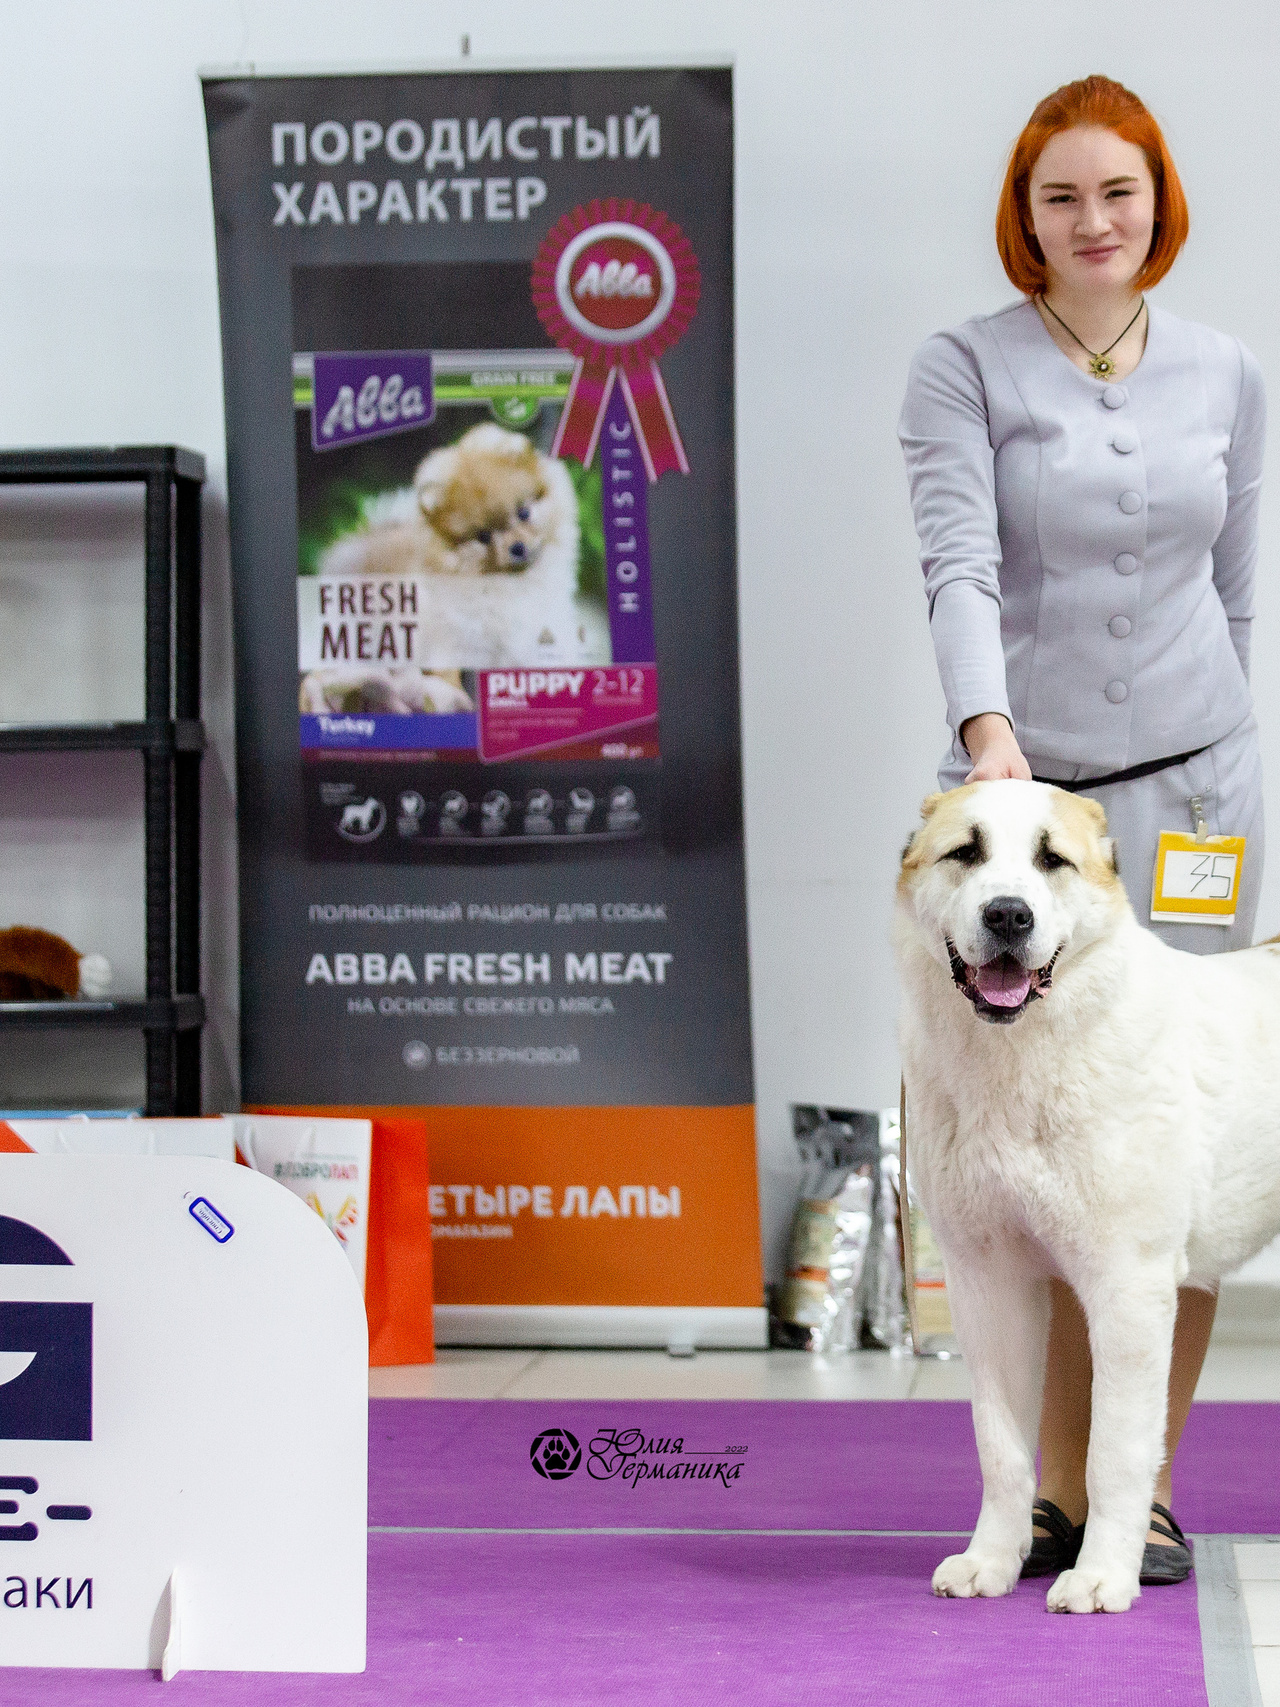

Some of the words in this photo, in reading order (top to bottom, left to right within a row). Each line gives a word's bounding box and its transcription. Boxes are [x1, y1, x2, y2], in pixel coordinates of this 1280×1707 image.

[270, 105, 663, 169] ПОРОДИСТЫЙ
[272, 176, 548, 226] ХАРАКТЕР
[320, 374, 427, 439] Abba
[608, 420, 640, 614] HOLISTIC
[318, 580, 419, 616] FRESH
[320, 621, 419, 661] MEAT
[486, 671, 586, 698] PUPPY
[592, 669, 645, 697] 2-12
[602, 902, 668, 922] СОБАК
[305, 952, 417, 985] ABBA
[424, 952, 551, 985] FRESH
[564, 952, 673, 985] MEAT
[347, 997, 375, 1014] НА
[428, 1184, 554, 1217] ЕТЫРЕ
[560, 1185, 682, 1218] ЛАПЫ
